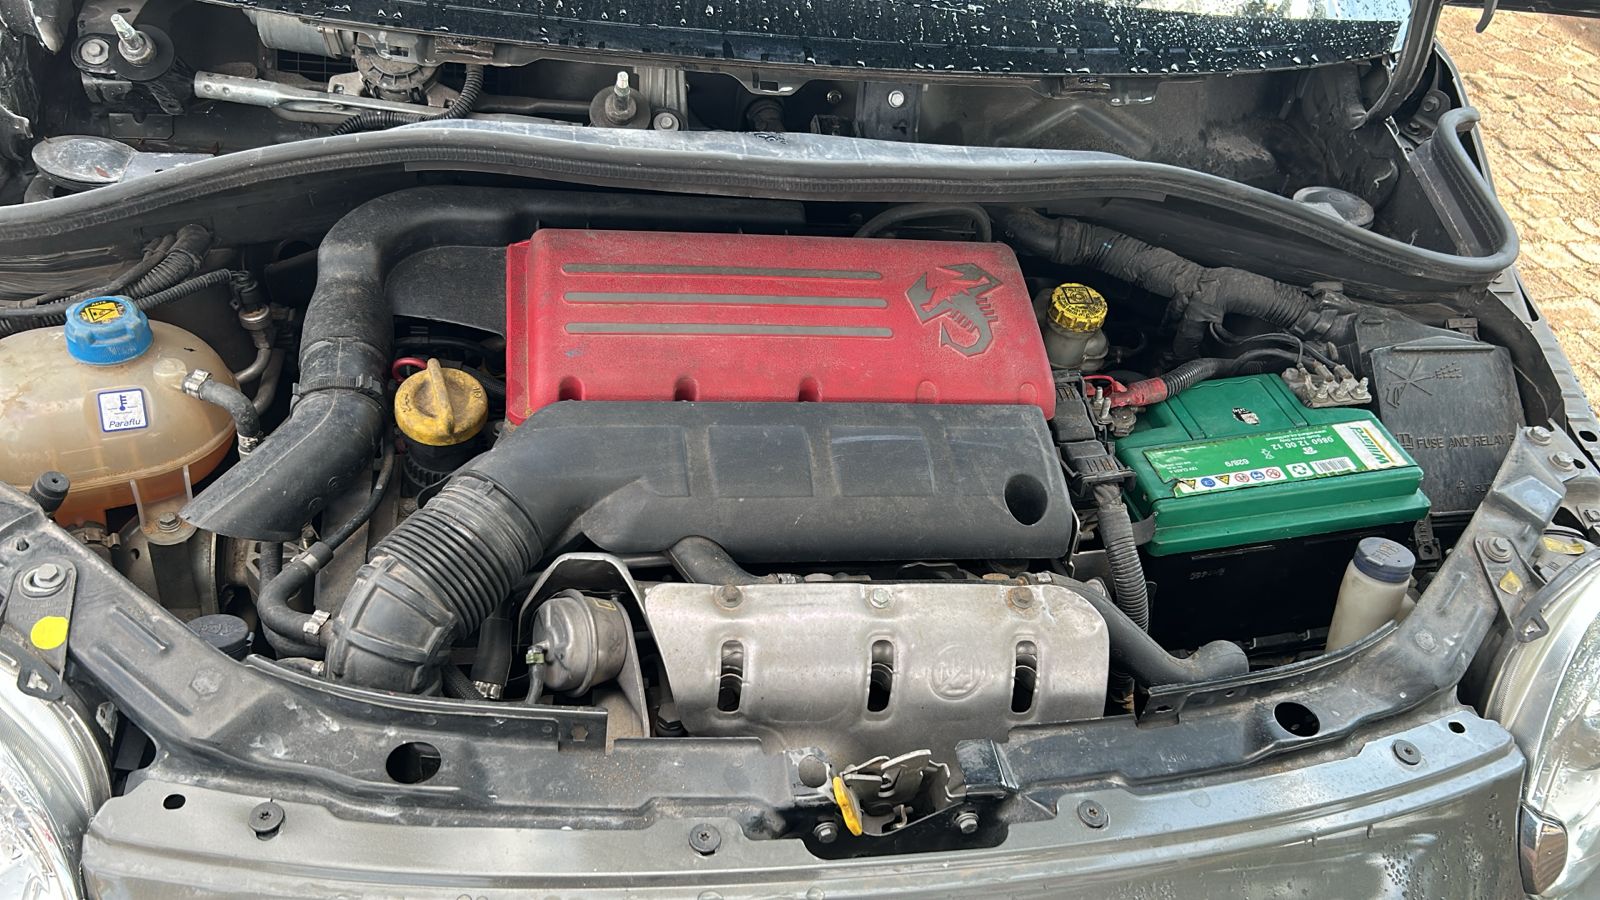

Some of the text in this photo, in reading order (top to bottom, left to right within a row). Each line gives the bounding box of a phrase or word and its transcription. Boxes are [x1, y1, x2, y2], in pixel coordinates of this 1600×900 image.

[108, 418, 141, 428] Paraflu
[1298, 439, 1310, 447] 12
[1311, 435, 1334, 445] 0860
[1417, 437, 1445, 449] FUSE
[1449, 436, 1469, 449] AND
[1472, 434, 1505, 448] RELAY
[1350, 426, 1390, 465] Willard
